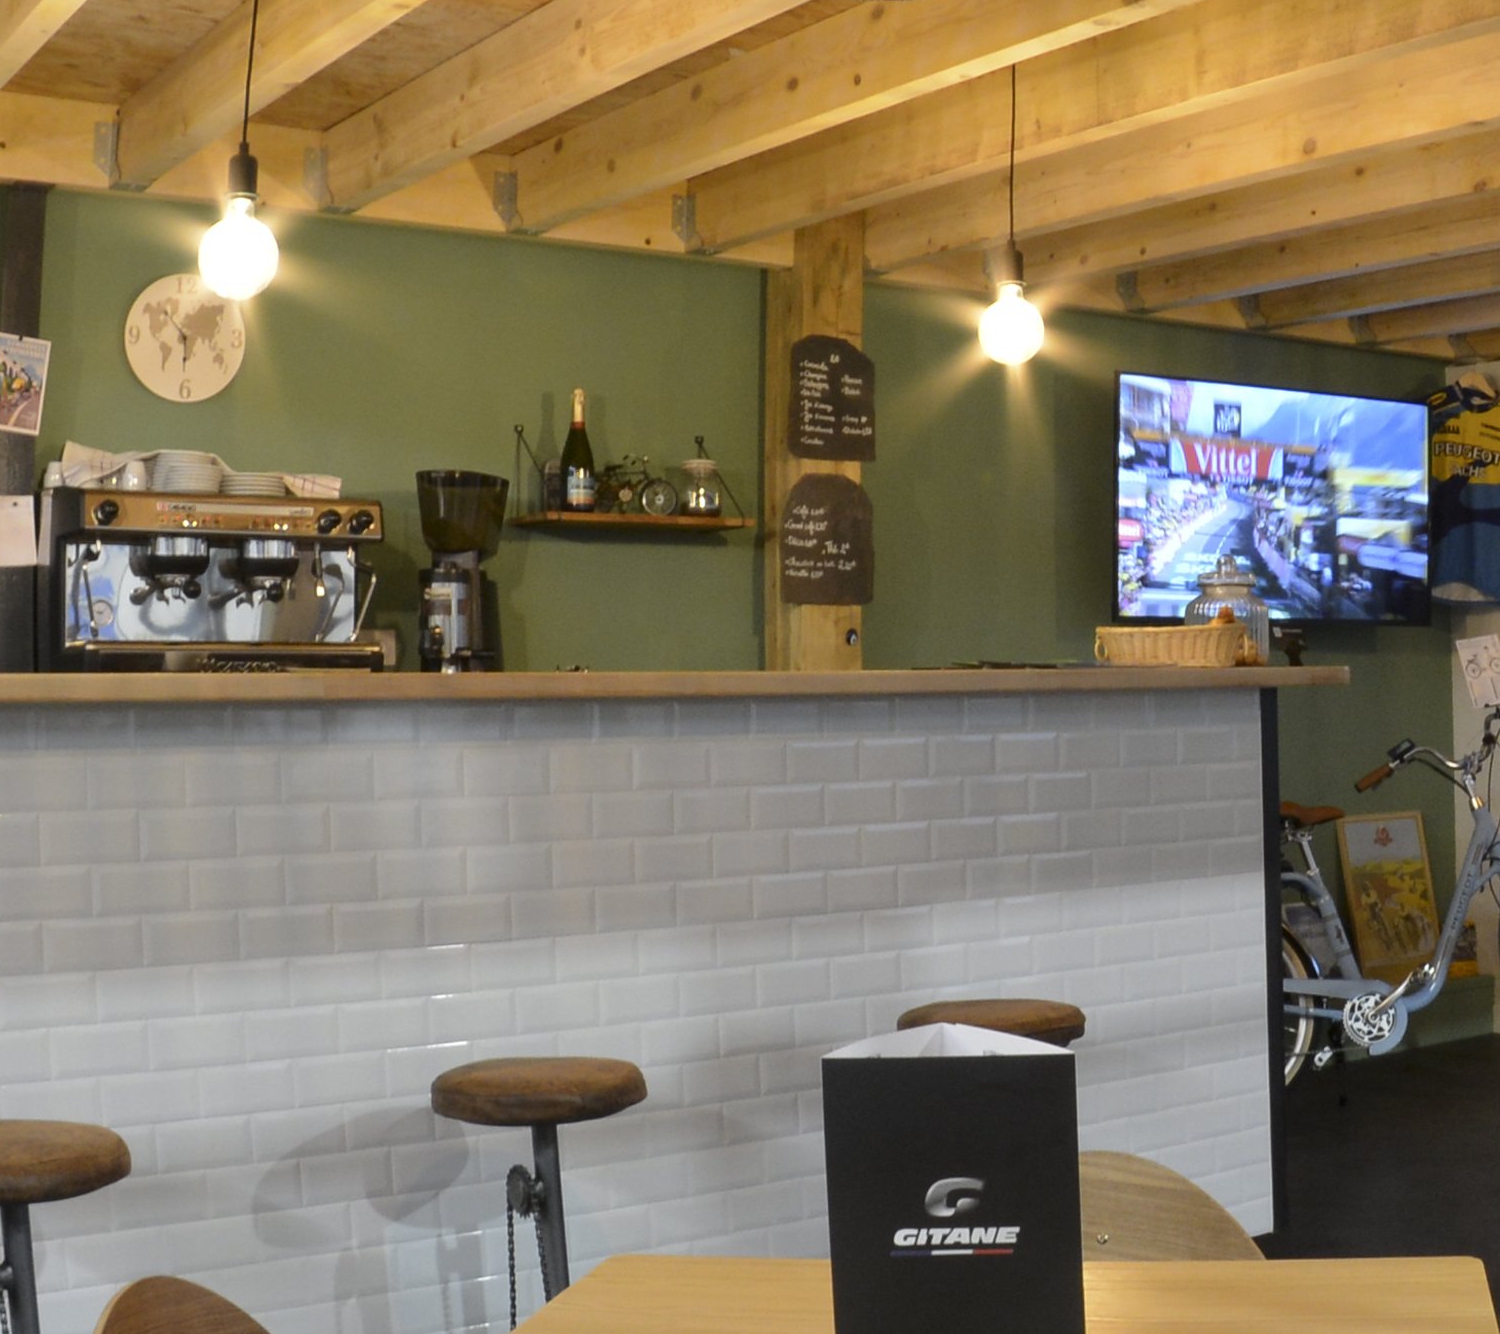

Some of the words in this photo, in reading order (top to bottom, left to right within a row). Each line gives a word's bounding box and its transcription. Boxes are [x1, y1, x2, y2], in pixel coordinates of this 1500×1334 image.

[175, 276, 197, 295] 12
[128, 325, 141, 345] 9
[230, 328, 243, 349] 3
[178, 378, 192, 400] 6
[1193, 442, 1258, 477] Vittel
[1434, 441, 1500, 465] PEUGEOT
[893, 1226, 1021, 1246] GITANE
